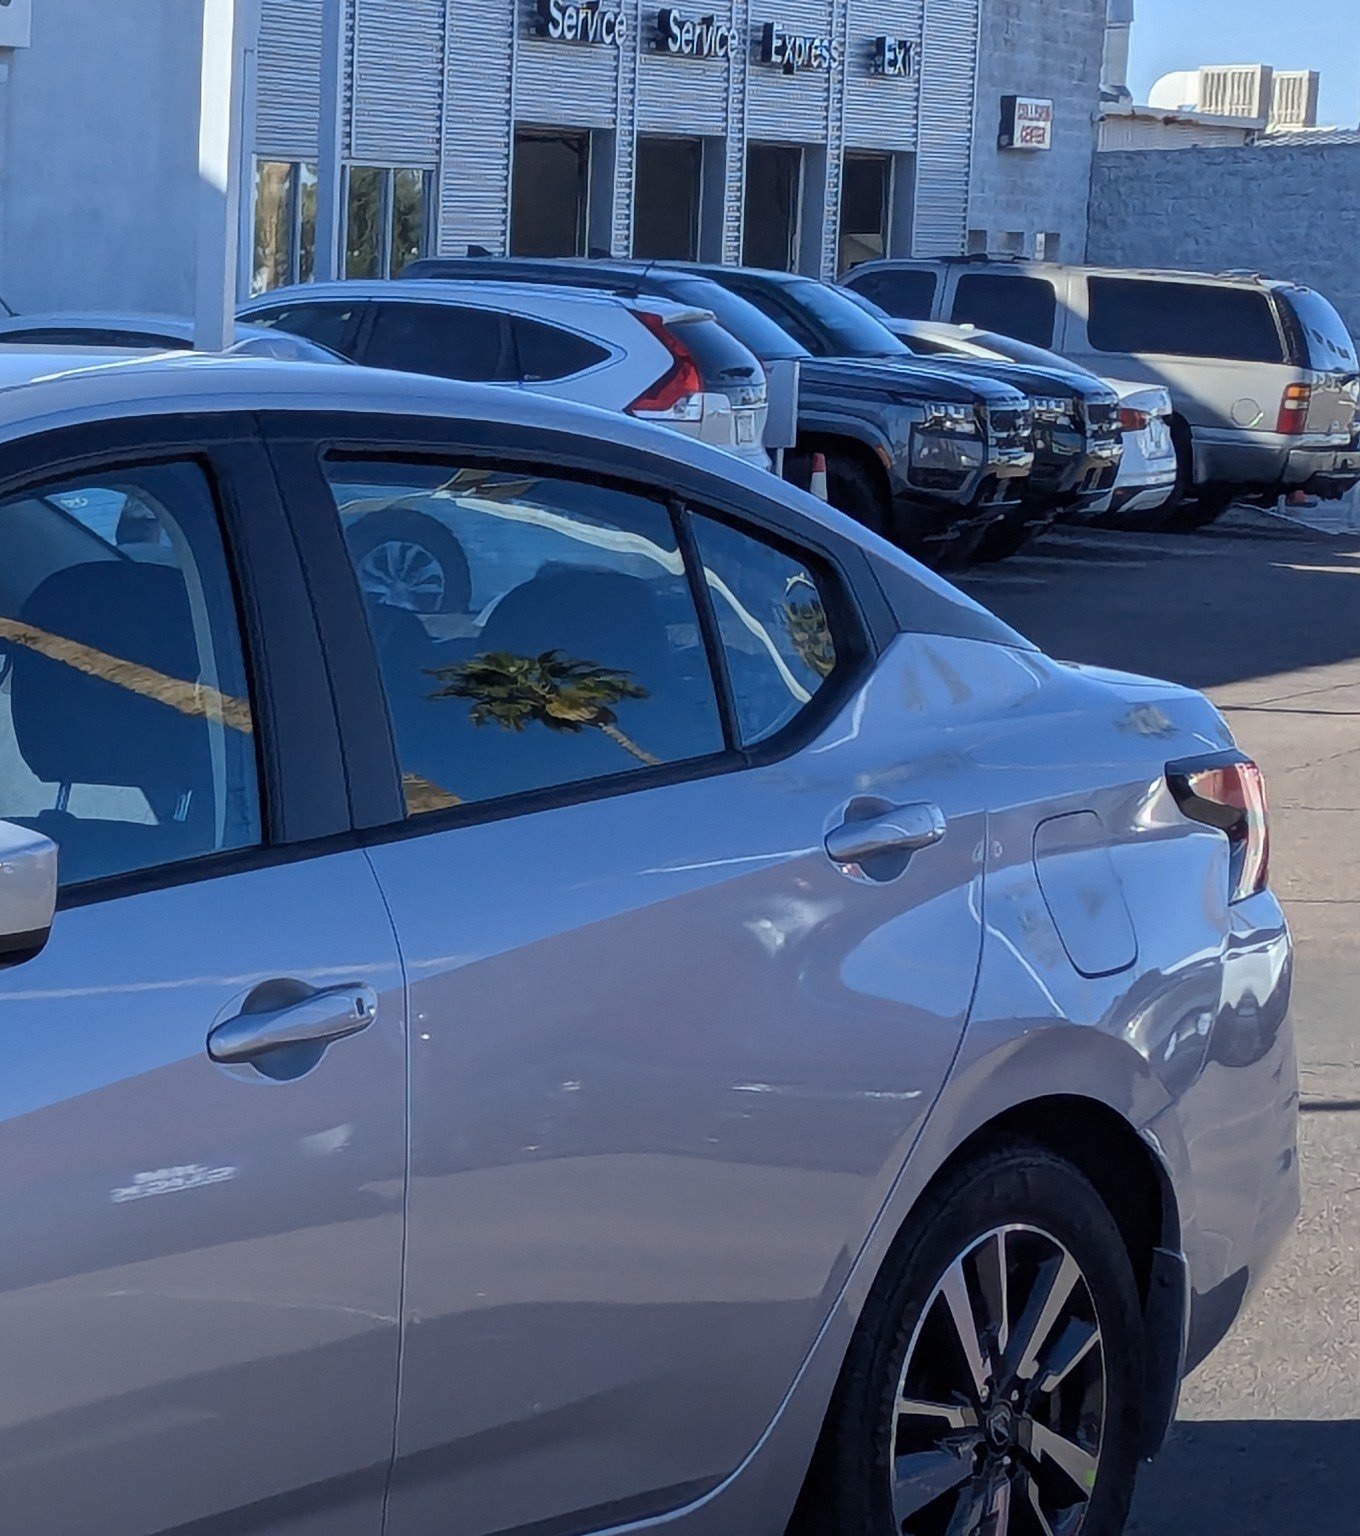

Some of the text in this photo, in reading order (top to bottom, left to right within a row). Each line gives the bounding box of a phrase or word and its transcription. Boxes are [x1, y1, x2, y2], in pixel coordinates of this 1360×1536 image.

[548, 0, 627, 45] Service
[668, 9, 739, 56] Service
[771, 21, 840, 70] Express
